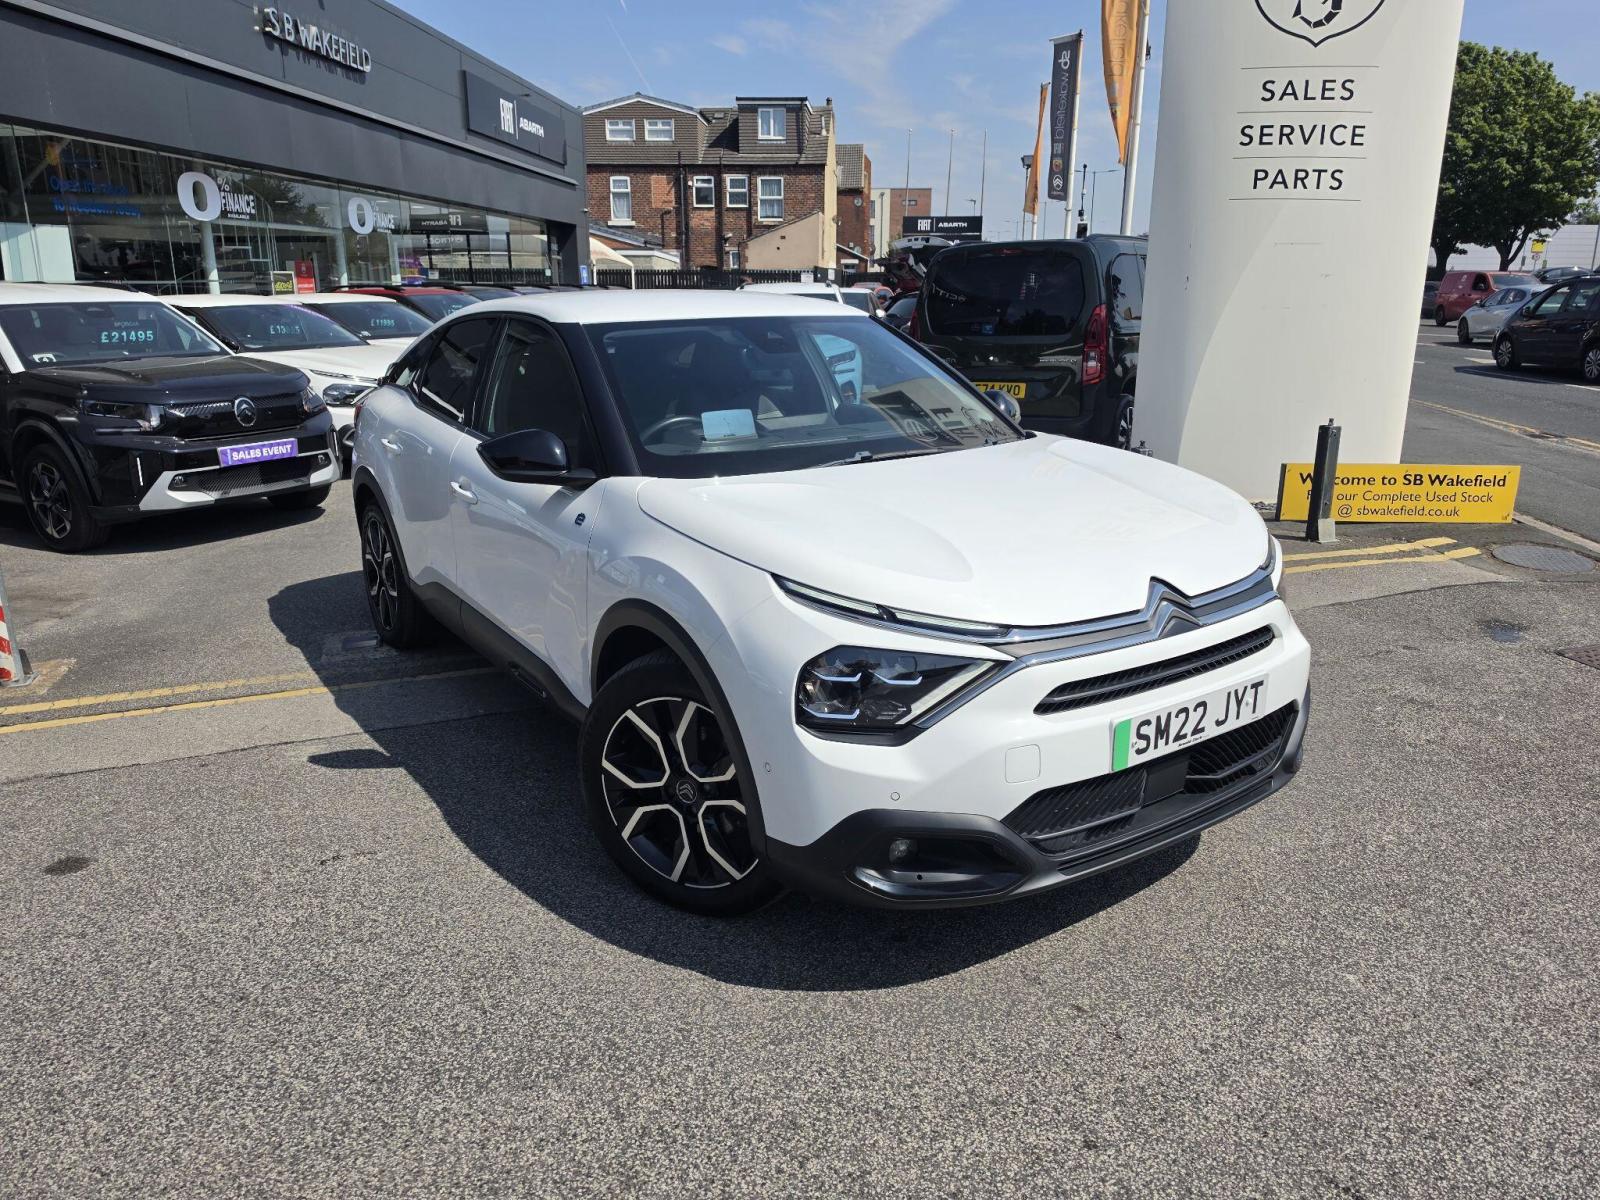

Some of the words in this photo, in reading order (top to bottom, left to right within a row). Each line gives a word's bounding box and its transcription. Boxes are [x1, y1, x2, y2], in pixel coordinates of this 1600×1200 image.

[297, 19, 372, 73] WAKEFIELD
[1260, 79, 1355, 102] SALES
[519, 117, 545, 138] ABARTH
[1239, 124, 1366, 146] SERVICE
[1252, 168, 1344, 191] PARTS
[220, 191, 256, 214] FINANCE
[917, 219, 932, 232] FIAT
[937, 221, 968, 229] ABARTH
[101, 330, 154, 344] £21495
[232, 449, 261, 461] SALES
[262, 445, 292, 457] EVENT
[1299, 472, 1376, 486] Wcome
[1381, 473, 1397, 486] to
[1402, 473, 1424, 486] SB
[1428, 473, 1507, 488] Wakefield
[1336, 492, 1359, 502] our
[1362, 490, 1421, 505] Complete
[1425, 491, 1456, 503] Used
[1460, 491, 1493, 503] Stock
[1337, 504, 1352, 518] @
[1356, 505, 1460, 518] sbwakefield.co.uk
[1134, 700, 1208, 756] SM22
[1215, 680, 1264, 727] JYT
